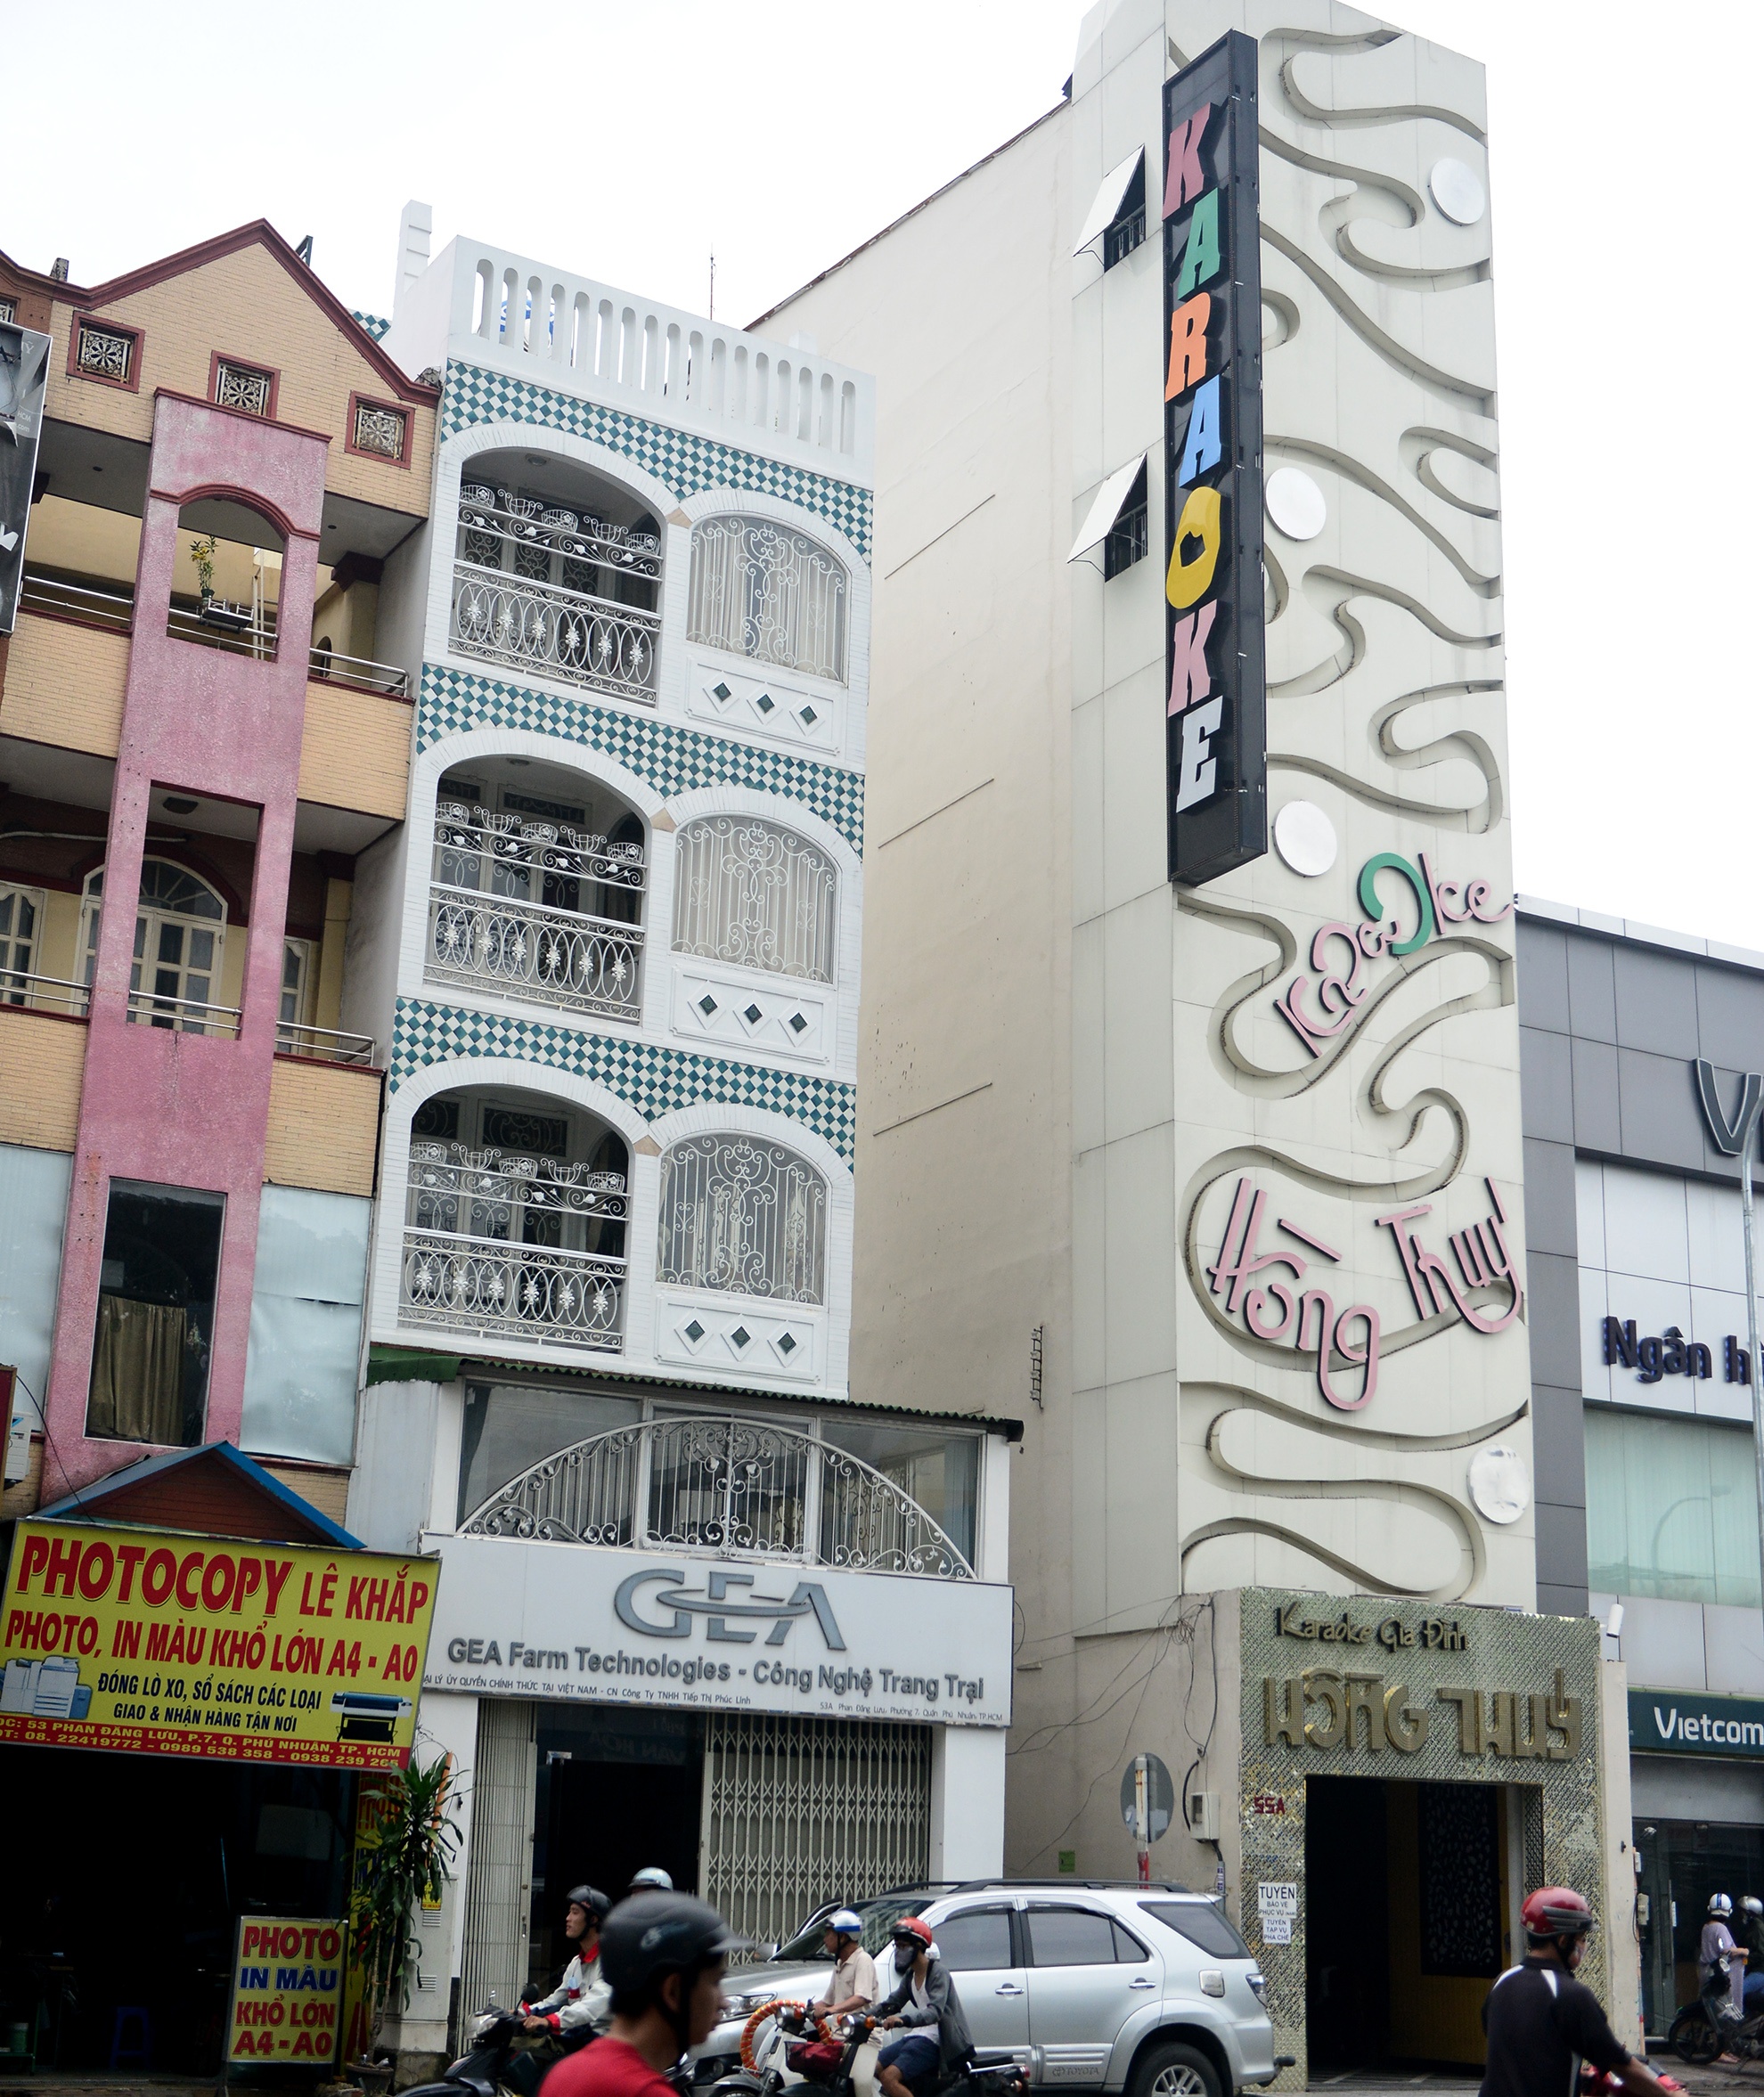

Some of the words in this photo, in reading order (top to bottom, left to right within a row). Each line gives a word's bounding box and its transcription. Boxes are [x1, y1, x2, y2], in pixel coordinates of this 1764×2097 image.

[1162, 102, 1222, 814] KARAOKE
[1605, 1316, 1713, 1383] Ngân
[15, 1535, 297, 1618] PHOTOCOPY
[299, 1563, 339, 1618] LÊ
[345, 1563, 429, 1624] KHẮP
[614, 1569, 847, 1651] GEA
[1276, 1603, 1373, 1644] Karaoke
[1377, 1617, 1415, 1653] Gia
[1422, 1619, 1470, 1651] Đình
[4, 1610, 102, 1658] PHOTO,
[111, 1620, 143, 1659] IN
[144, 1618, 207, 1665] MÀU
[208, 1620, 267, 1670] KHỔ
[270, 1628, 324, 1675] LỚN
[326, 1639, 362, 1677] A4
[448, 1637, 502, 1667] GEA
[509, 1642, 569, 1670] Farm
[575, 1646, 731, 1685] Technologies
[754, 1660, 813, 1693] Công
[819, 1664, 873, 1697] Nghệ
[879, 1668, 939, 1701] Trang
[944, 1674, 984, 1703] Trại
[97, 1669, 139, 1695] ĐÓNG
[143, 1671, 161, 1697] LÒ
[164, 1678, 187, 1702] XO,
[192, 1673, 215, 1701] SỔ
[216, 1677, 254, 1704] SÁCH
[257, 1682, 286, 1707] CÁC
[290, 1689, 323, 1715] LOẠI
[489, 1677, 513, 1689] CHÍNH
[577, 1685, 597, 1695] NAM
[607, 1687, 617, 1696] CN
[645, 1689, 655, 1700] Ty
[658, 1690, 679, 1701] TNHH
[715, 1694, 732, 1704] Phúc
[820, 1701, 833, 1710] 53A
[113, 1702, 146, 1720] GIAO
[150, 1707, 159, 1721] &
[164, 1706, 203, 1727] NHẬN
[205, 1708, 241, 1728] HÀNG
[246, 1711, 271, 1733] TẬN
[274, 1715, 298, 1732] NƠI
[1654, 1706, 1764, 1746] Vietcom
[28, 1720, 47, 1729] 53
[53, 1722, 94, 1734] PHAN
[100, 1726, 143, 1738] ĐĂNG
[242, 1737, 274, 1748] PHÚ
[339, 1745, 361, 1754] TP.
[367, 1747, 401, 1757] HCM
[58, 1734, 142, 1749] 22419772
[159, 1742, 201, 1754] 0989
[207, 1746, 237, 1756] 538
[242, 1749, 273, 1758] 358
[290, 1752, 331, 1763] 0938
[335, 1755, 364, 1765] 239
[242, 1926, 341, 1961] PHOTO
[240, 1966, 270, 1990] IN
[275, 1963, 339, 1992] MÀU
[235, 1994, 285, 2027] KHỔ
[290, 1998, 335, 2028] LỚN
[233, 2030, 275, 2056] A4
[1066, 2067, 1098, 2076] TOYOTA
